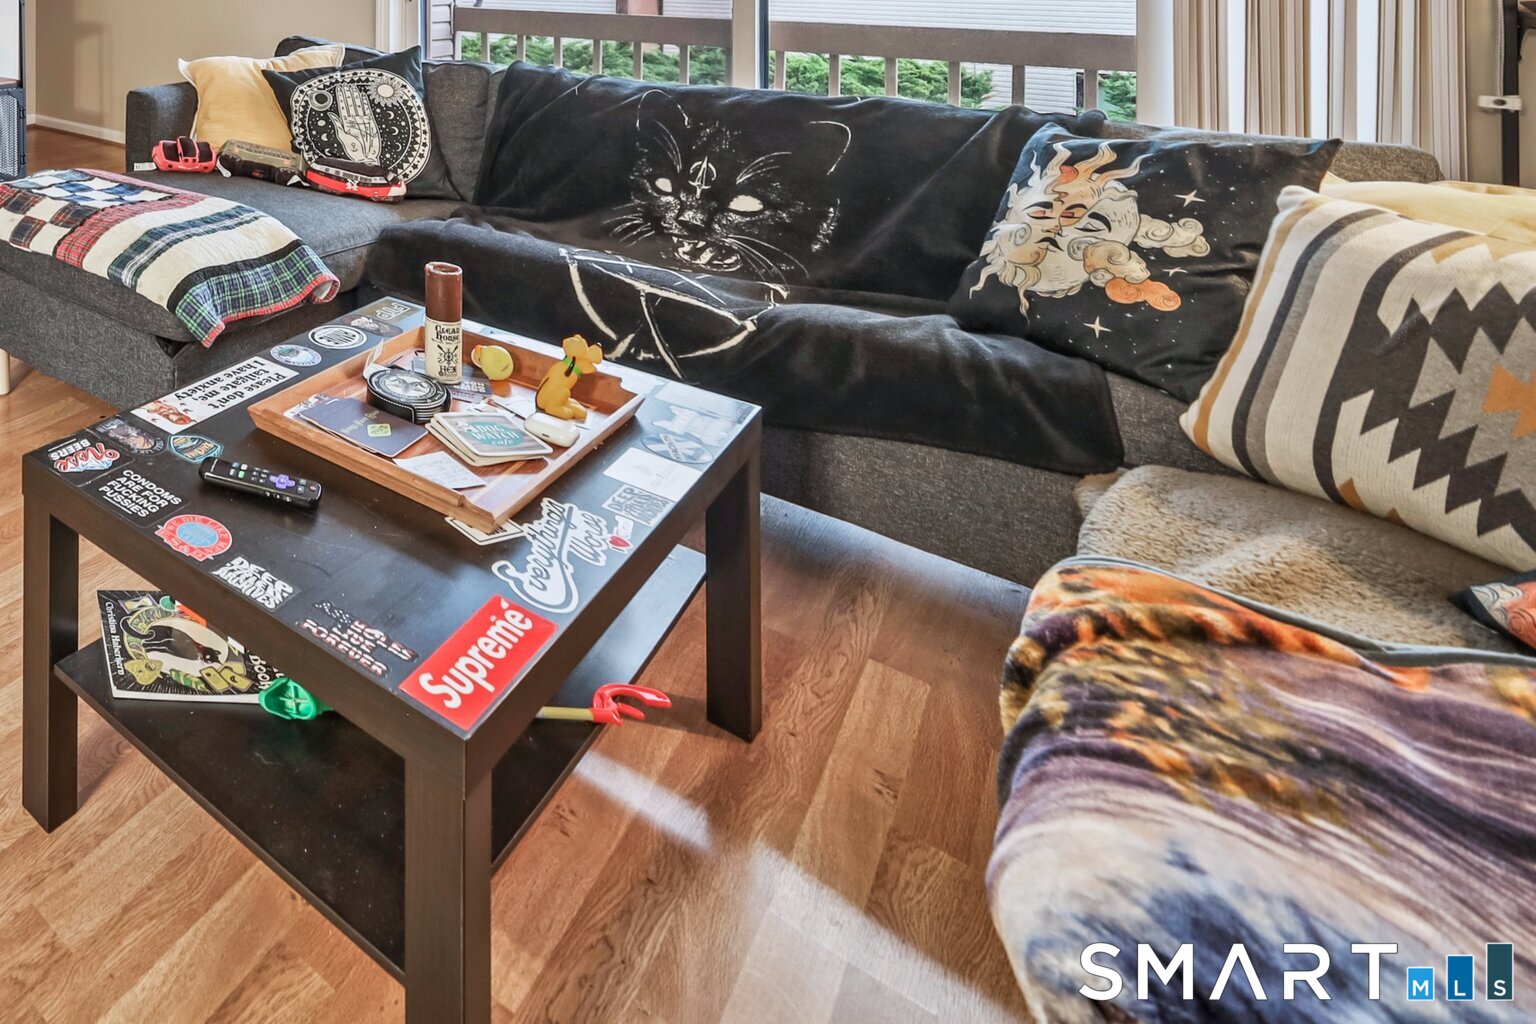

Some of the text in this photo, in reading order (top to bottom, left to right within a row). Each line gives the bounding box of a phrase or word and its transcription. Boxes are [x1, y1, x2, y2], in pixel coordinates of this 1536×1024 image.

[192, 368, 270, 401] tailgate me,
[226, 363, 257, 378] have
[175, 376, 224, 401] anxiety
[208, 372, 286, 410] Please don't
[472, 430, 520, 441] WATCH
[475, 424, 505, 432] DOG
[49, 438, 91, 461] BEERS
[98, 486, 150, 518] PUSSIES
[107, 480, 160, 514] FUCKING
[116, 476, 168, 508] ARE FOR
[122, 469, 182, 506] CONDOMS
[212, 570, 276, 609] ARCHIVES
[230, 556, 294, 594] DEEP
[105, 601, 117, 634] Christina
[299, 618, 388, 675] FOREVER
[332, 622, 377, 654] LIVE
[419, 605, 533, 709] Supreme
